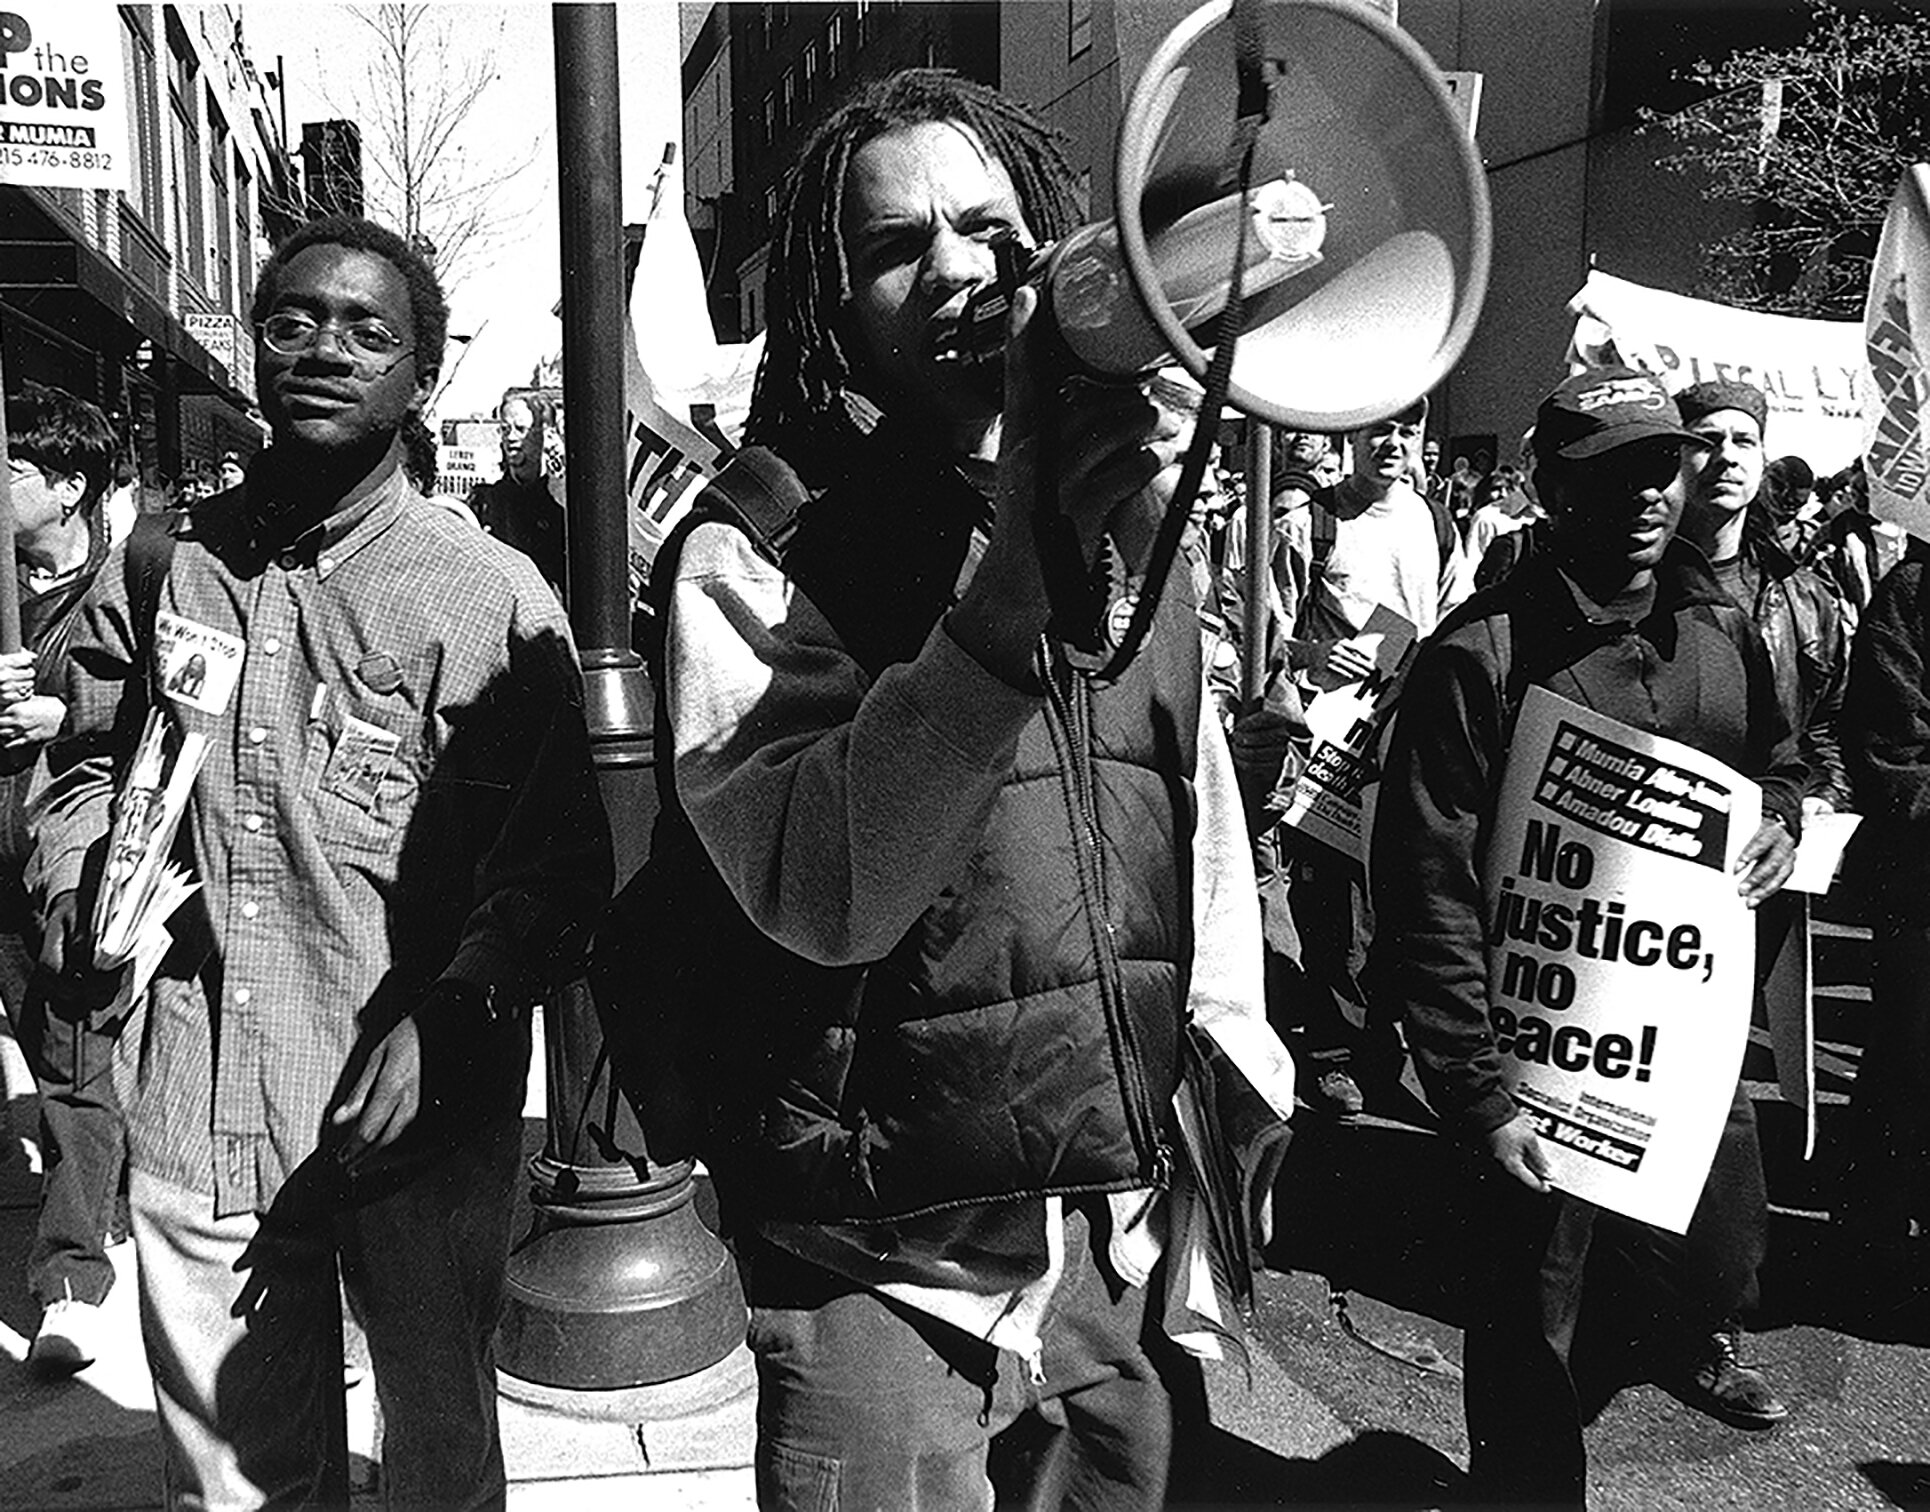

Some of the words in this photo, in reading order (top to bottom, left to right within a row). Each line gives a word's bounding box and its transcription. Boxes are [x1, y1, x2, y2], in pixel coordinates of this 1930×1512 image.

[34, 42, 88, 75] the
[9, 123, 93, 146] MUMIA
[189, 315, 234, 329] PIZZA
[1574, 738, 1647, 782] Mumia
[1564, 764, 1627, 801] Abner
[1555, 789, 1642, 838] Amadou
[1519, 818, 1595, 890] No
[1489, 875, 1714, 983] justice,
[1500, 951, 1577, 1012] no
[1489, 1006, 1658, 1083] eace!
[1554, 1122, 1640, 1165] Worker
